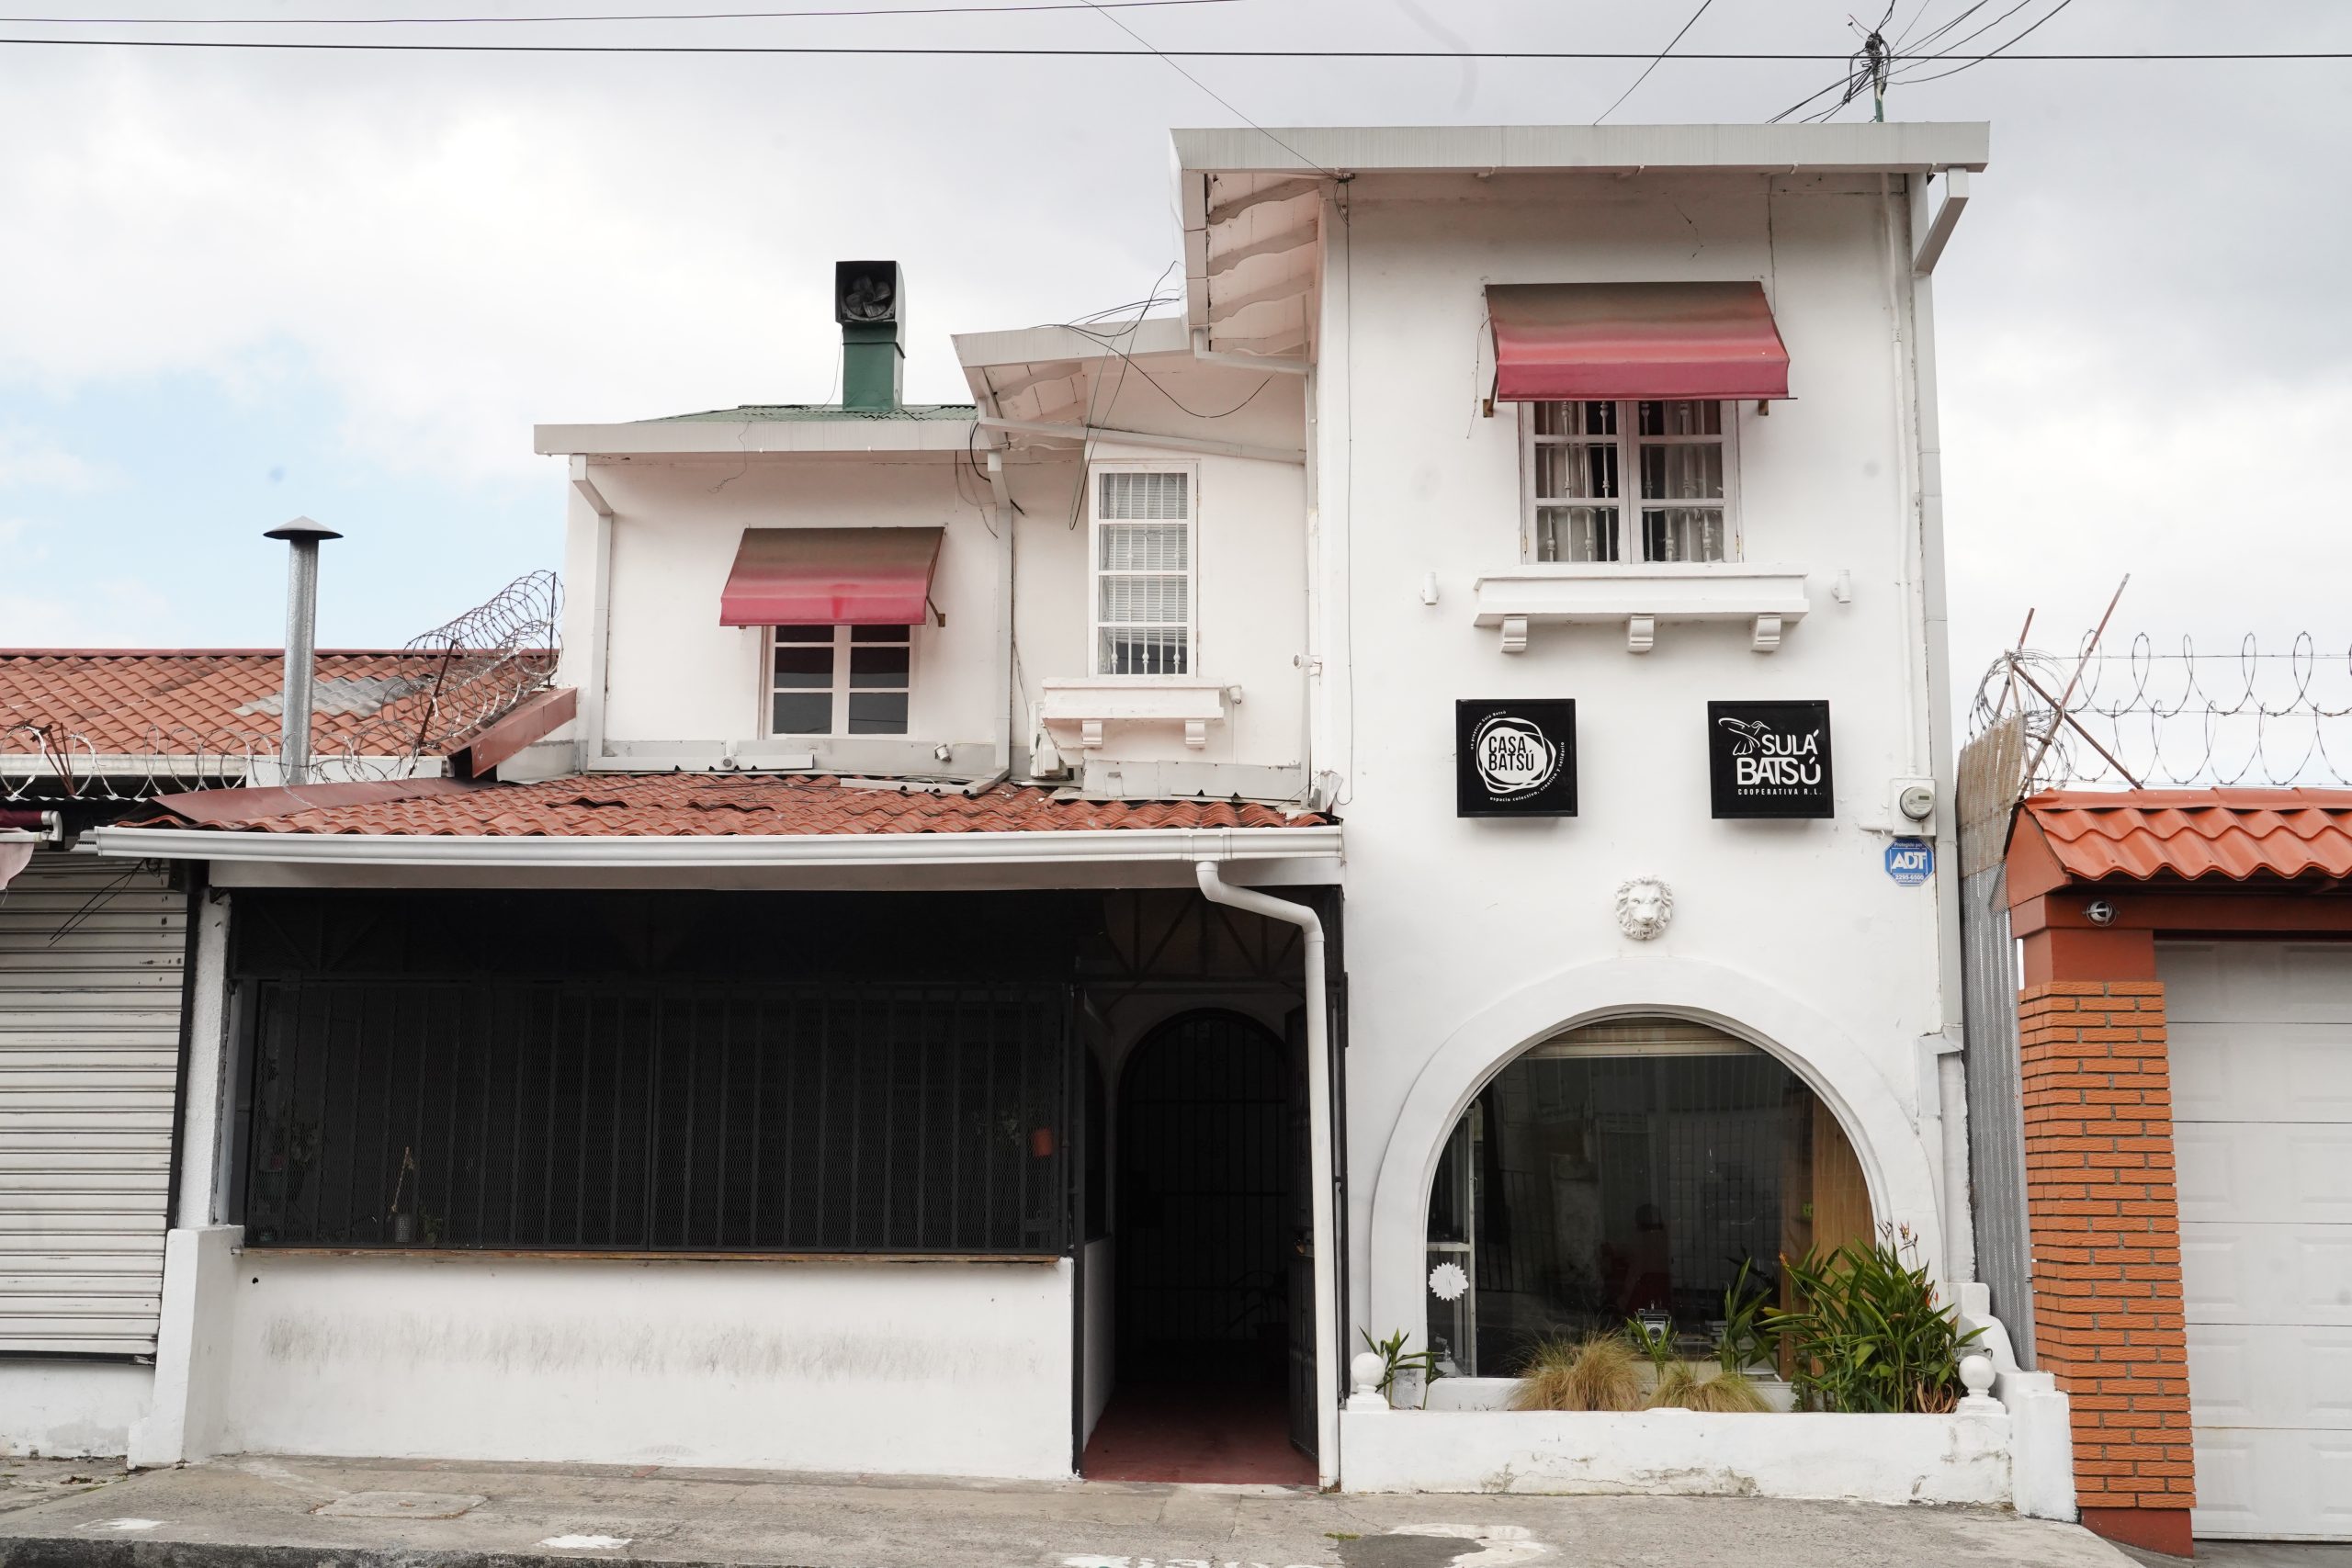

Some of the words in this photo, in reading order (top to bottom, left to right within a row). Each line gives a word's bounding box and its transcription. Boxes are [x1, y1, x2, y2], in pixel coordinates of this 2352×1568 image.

[1488, 736, 1527, 754] CASA
[1761, 729, 1820, 755] SULÁ
[1488, 750, 1534, 772] BATSÚ
[1736, 756, 1822, 785] BATSÚ
[1512, 791, 1540, 802] colectivo,
[1540, 773, 1557, 791] creativo
[1891, 852, 1926, 869] ADT
